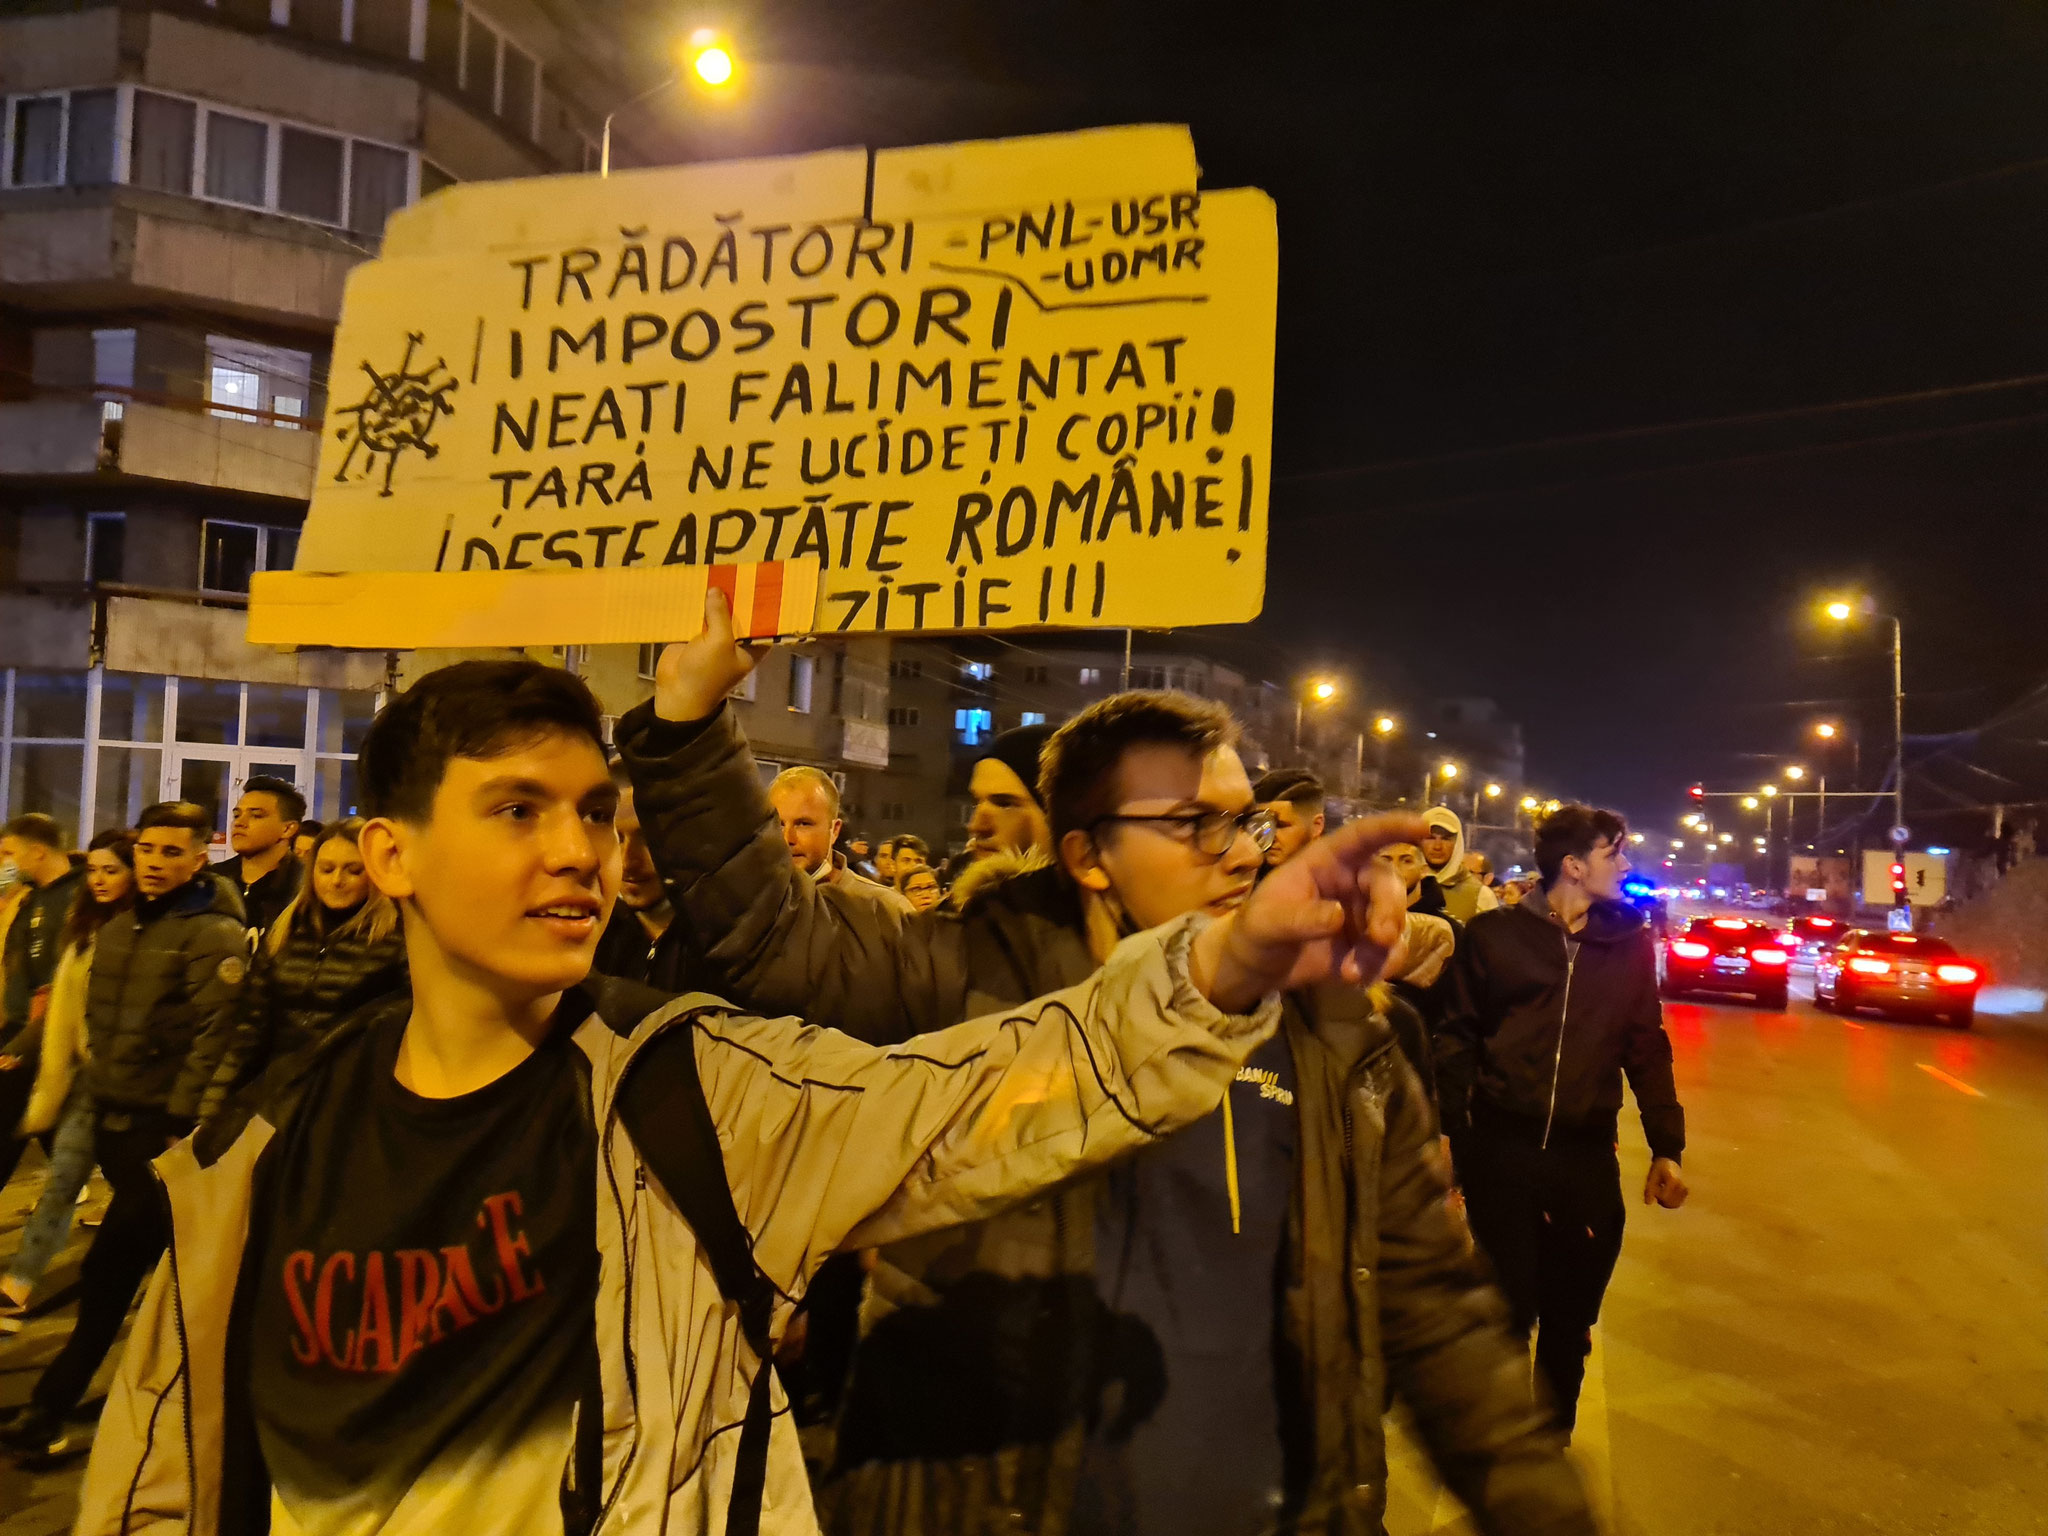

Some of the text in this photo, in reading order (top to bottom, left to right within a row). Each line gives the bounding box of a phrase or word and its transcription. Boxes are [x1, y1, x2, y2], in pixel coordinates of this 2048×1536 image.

[510, 286, 1012, 379] IMPOSTORI
[729, 337, 1187, 423] FALIMENTAT
[689, 441, 774, 493] NE
